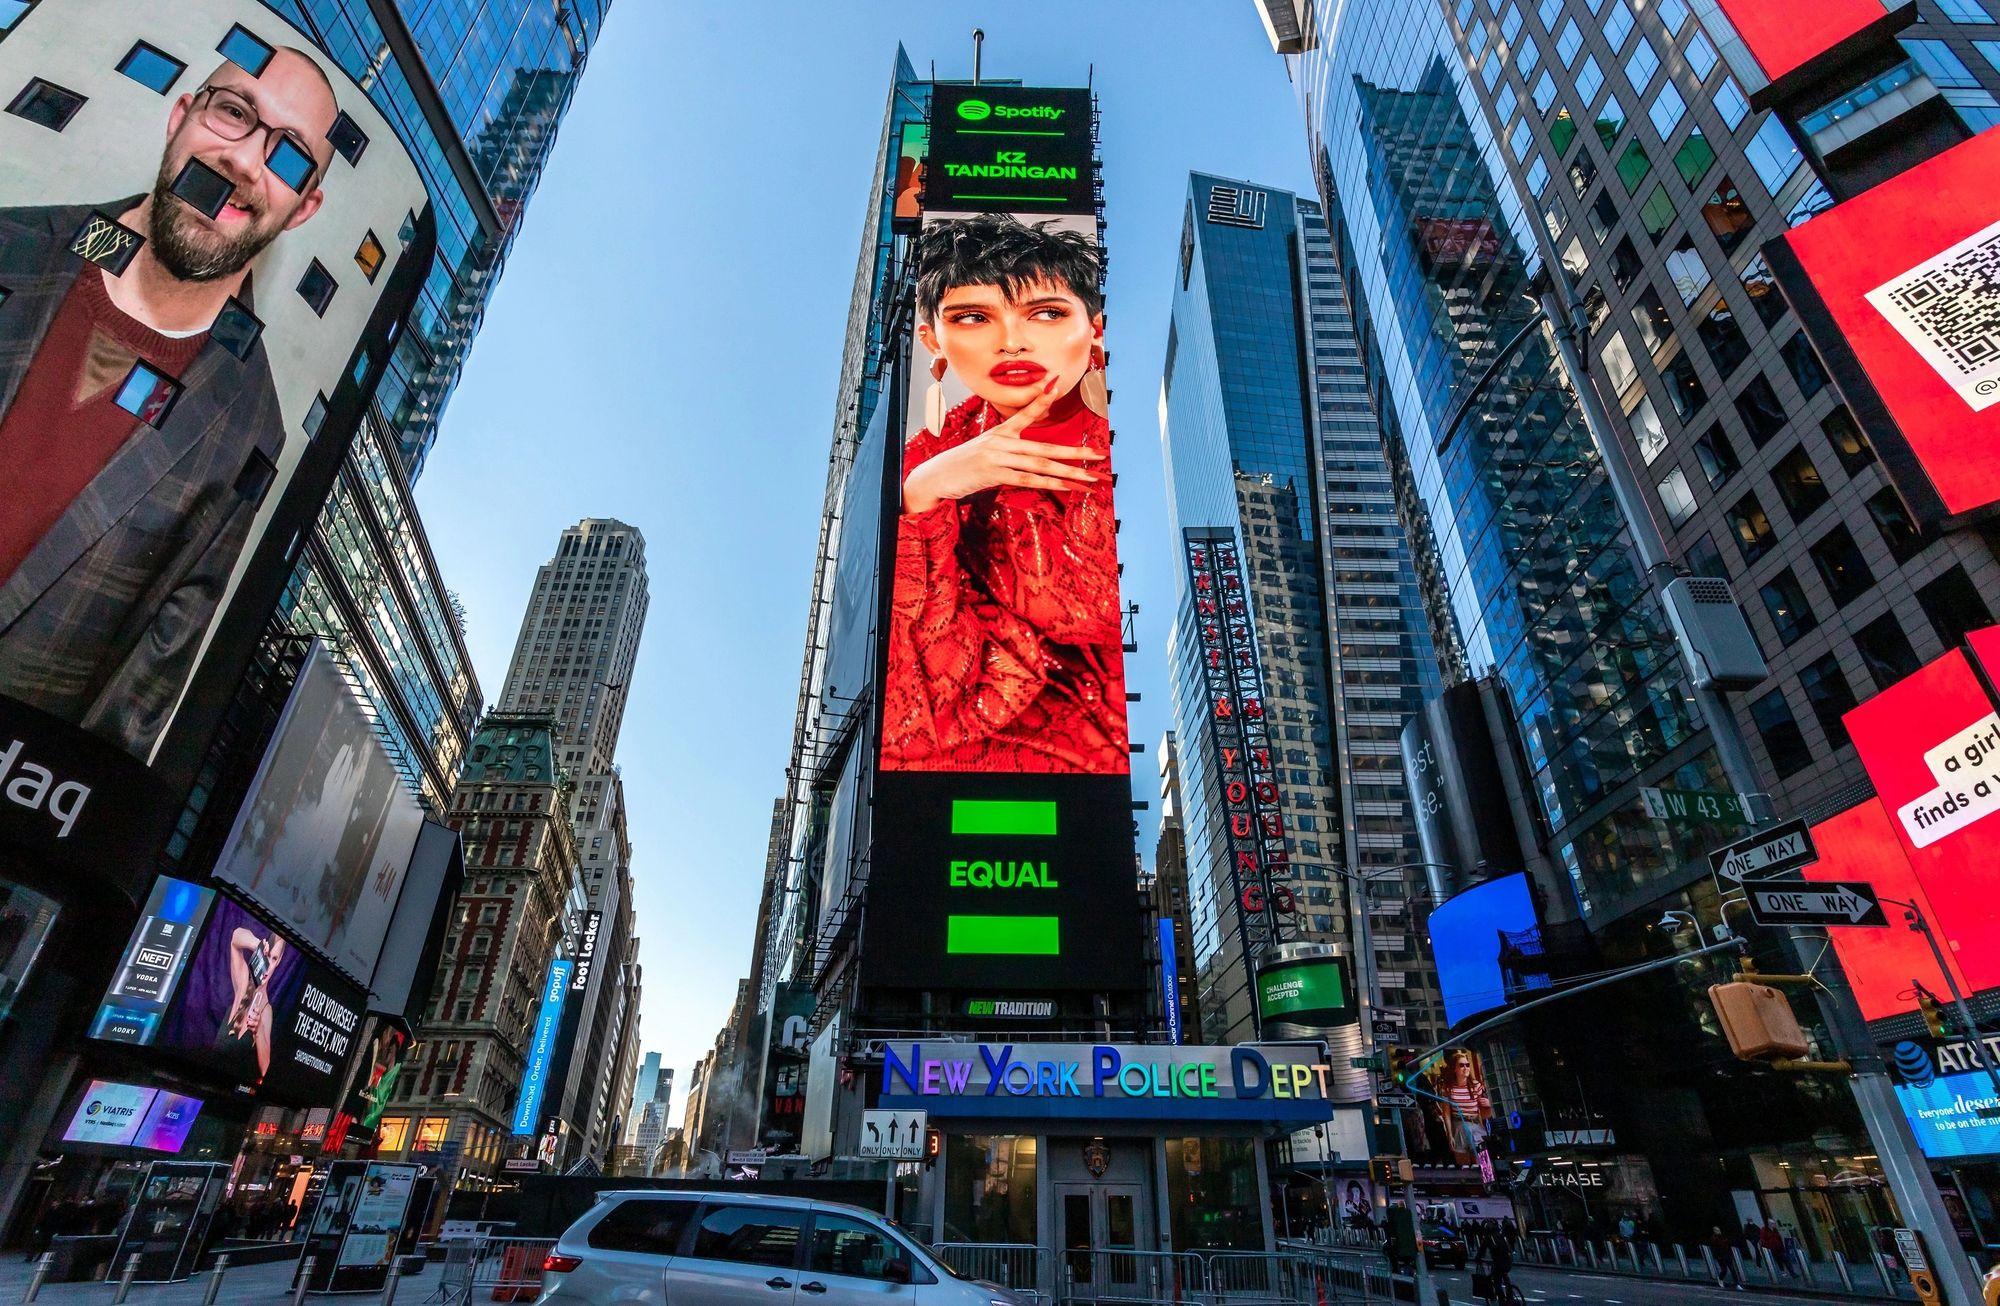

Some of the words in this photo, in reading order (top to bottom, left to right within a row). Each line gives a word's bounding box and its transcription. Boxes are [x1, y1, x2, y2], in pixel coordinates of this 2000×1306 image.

[994, 105, 1066, 120] Spotify
[996, 152, 1026, 164] KZ
[944, 164, 1077, 180] TANDINGAN
[1215, 698, 1232, 717] &
[1945, 755, 1961, 772] a
[1666, 793, 1688, 816] W
[1697, 795, 1720, 818] 43
[1913, 791, 1970, 829] finds
[1974, 780, 1991, 797] a
[1223, 748, 1264, 914] YOUNG
[1726, 854, 1756, 876] ONE
[1763, 837, 1797, 862] WAY
[950, 861, 1058, 888] EQUAL
[1767, 894, 1809, 912] ONE
[1823, 894, 1860, 912] WAY
[579, 913, 600, 957] Locker
[141, 953, 169, 966] NEFT
[136, 973, 158, 983] VODKA
[549, 966, 566, 1003] gopuff
[572, 961, 590, 990] Foot
[1266, 980, 1303, 994] CHALLENGE
[1267, 989, 1299, 1002] ACCEPTED
[301, 984, 326, 1014] POUR
[323, 996, 358, 1032] YOURSELF
[294, 1011, 314, 1038] THE
[310, 1020, 333, 1052] BEST,
[329, 1031, 349, 1057] NYC!
[1936, 1036, 2000, 1073] AT&T
[530, 1056, 543, 1081] Order.
[883, 1041, 973, 1096] NEW
[978, 1044, 1081, 1096] YORK
[1093, 1045, 1219, 1098] POLICE
[1230, 1047, 1330, 1099] DEPT
[103, 1105, 134, 1116] VIATRIS
[1918, 1107, 1955, 1119] Everyone
[1935, 1122, 1946, 1131] to
[1945, 1120, 1957, 1130] be
[1957, 1119, 1970, 1128] on
[1969, 1116, 1987, 1127] the
[862, 1146, 879, 1155] ONLY
[882, 1146, 899, 1155] ONLY
[903, 1147, 920, 1156] ONLY
[931, 1135, 938, 1153] 3
[1540, 1173, 1603, 1187] CHASE
